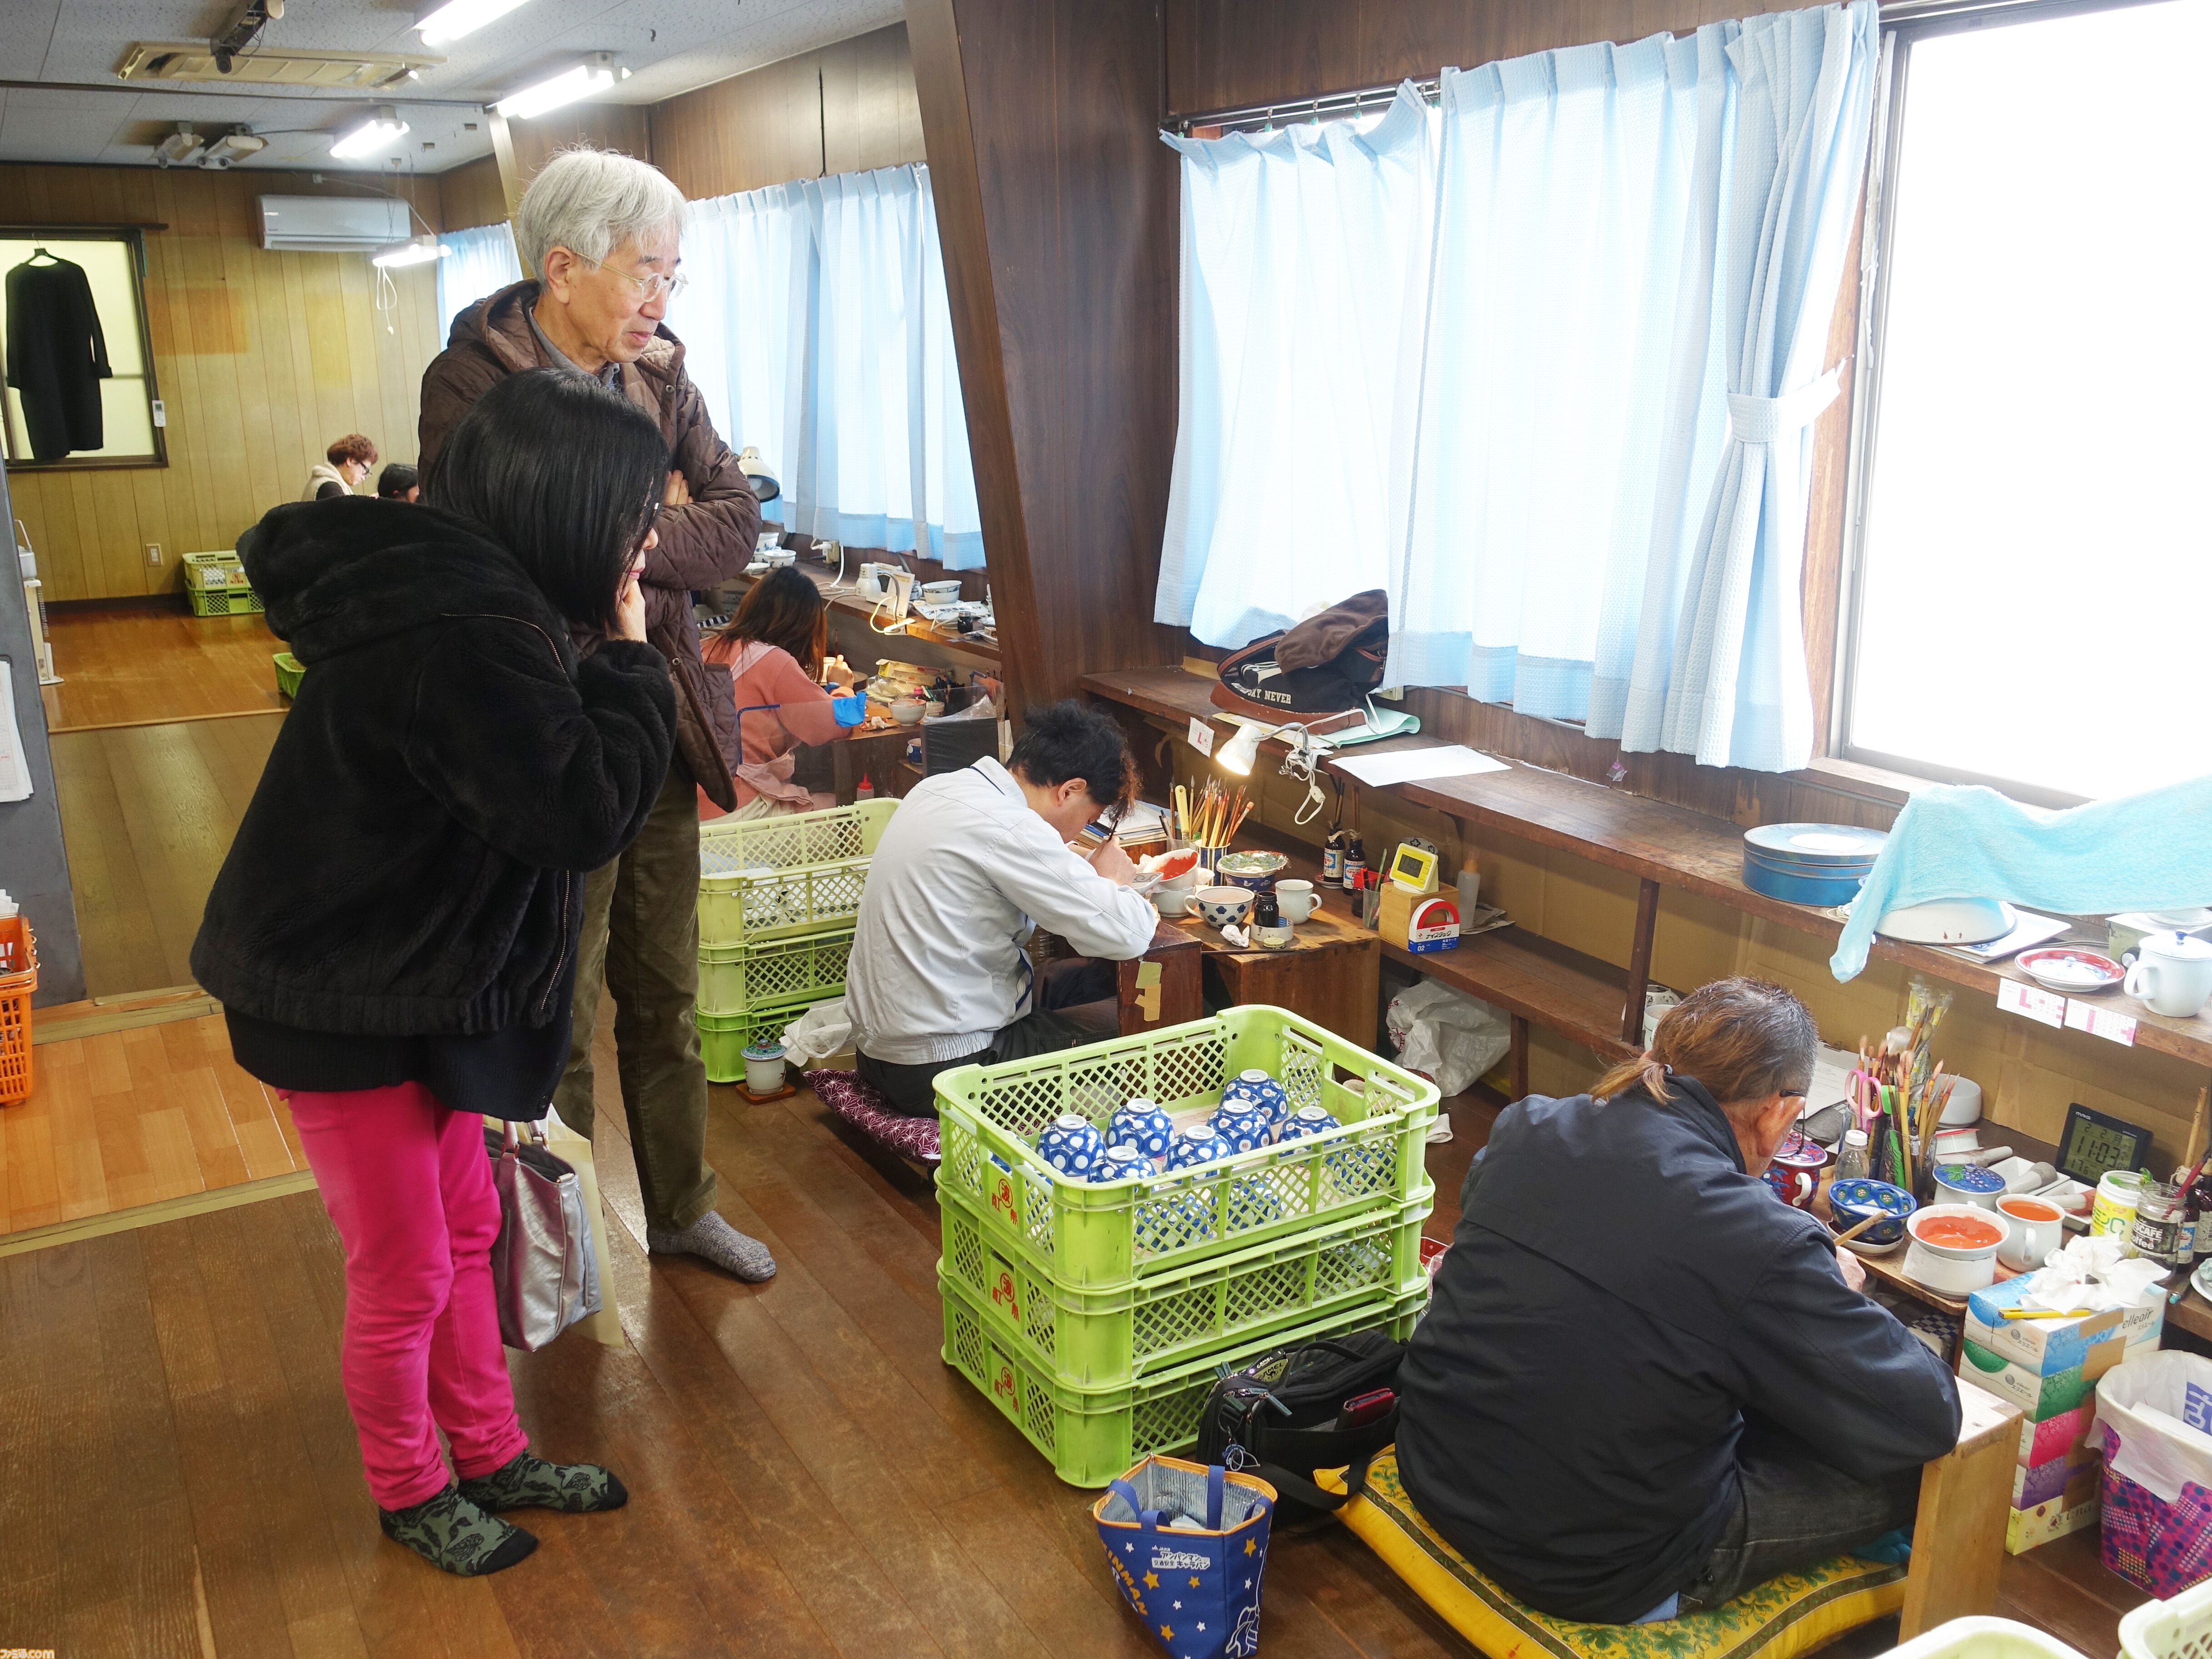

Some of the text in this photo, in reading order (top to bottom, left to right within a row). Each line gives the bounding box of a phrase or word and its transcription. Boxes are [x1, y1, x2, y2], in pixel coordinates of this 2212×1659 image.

[1264, 690, 1292, 704] NEVER
[1426, 930, 1452, 939] ナイスタック
[2133, 1222, 2163, 1239] ESCAFÉ
[2122, 1309, 2154, 1329] elleair
[2017, 1339, 2039, 1352] エリエール
[1258, 1362, 1283, 1381] CAMEL
[2011, 1385, 2033, 1398] エリエール
[1161, 1552, 1202, 1562] アンパンマン
[1176, 1560, 1209, 1569] キャラバン
